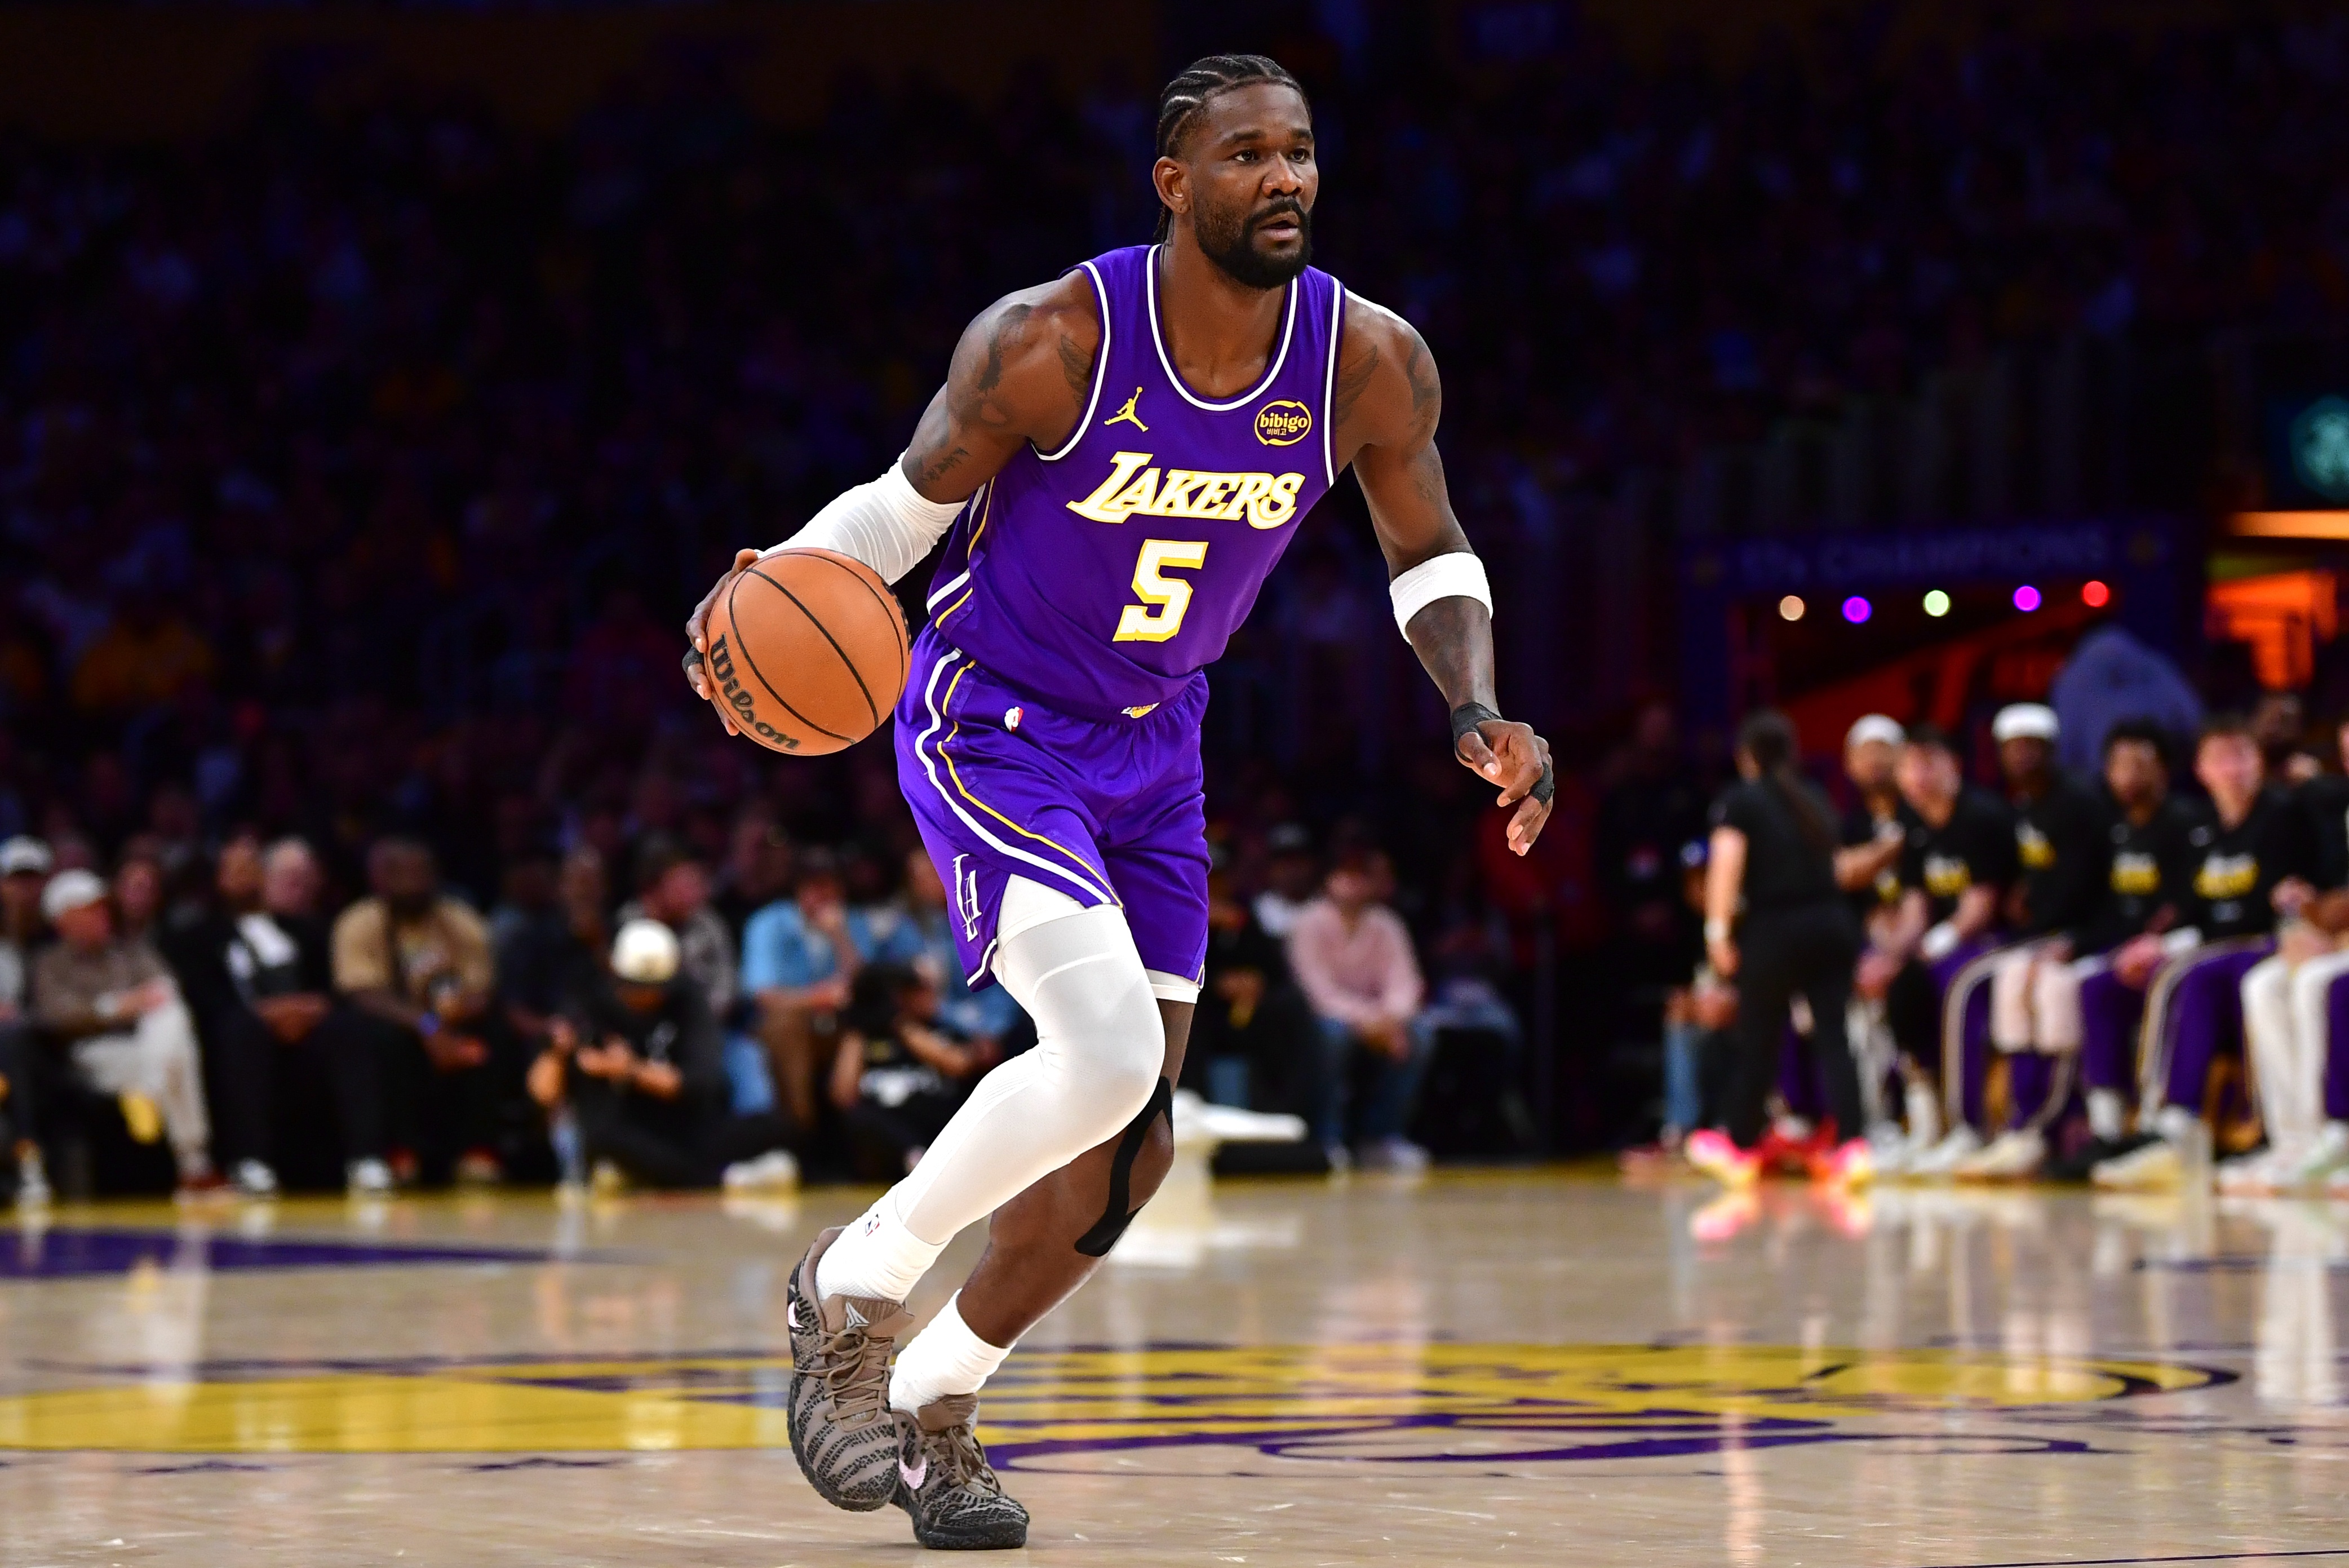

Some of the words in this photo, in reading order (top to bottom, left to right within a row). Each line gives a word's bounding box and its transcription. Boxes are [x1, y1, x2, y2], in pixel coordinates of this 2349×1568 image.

[1260, 412, 1308, 433] bibigo
[1066, 451, 1306, 529] LAKERS
[1113, 539, 1209, 643] 5
[710, 631, 800, 750] Wilson
